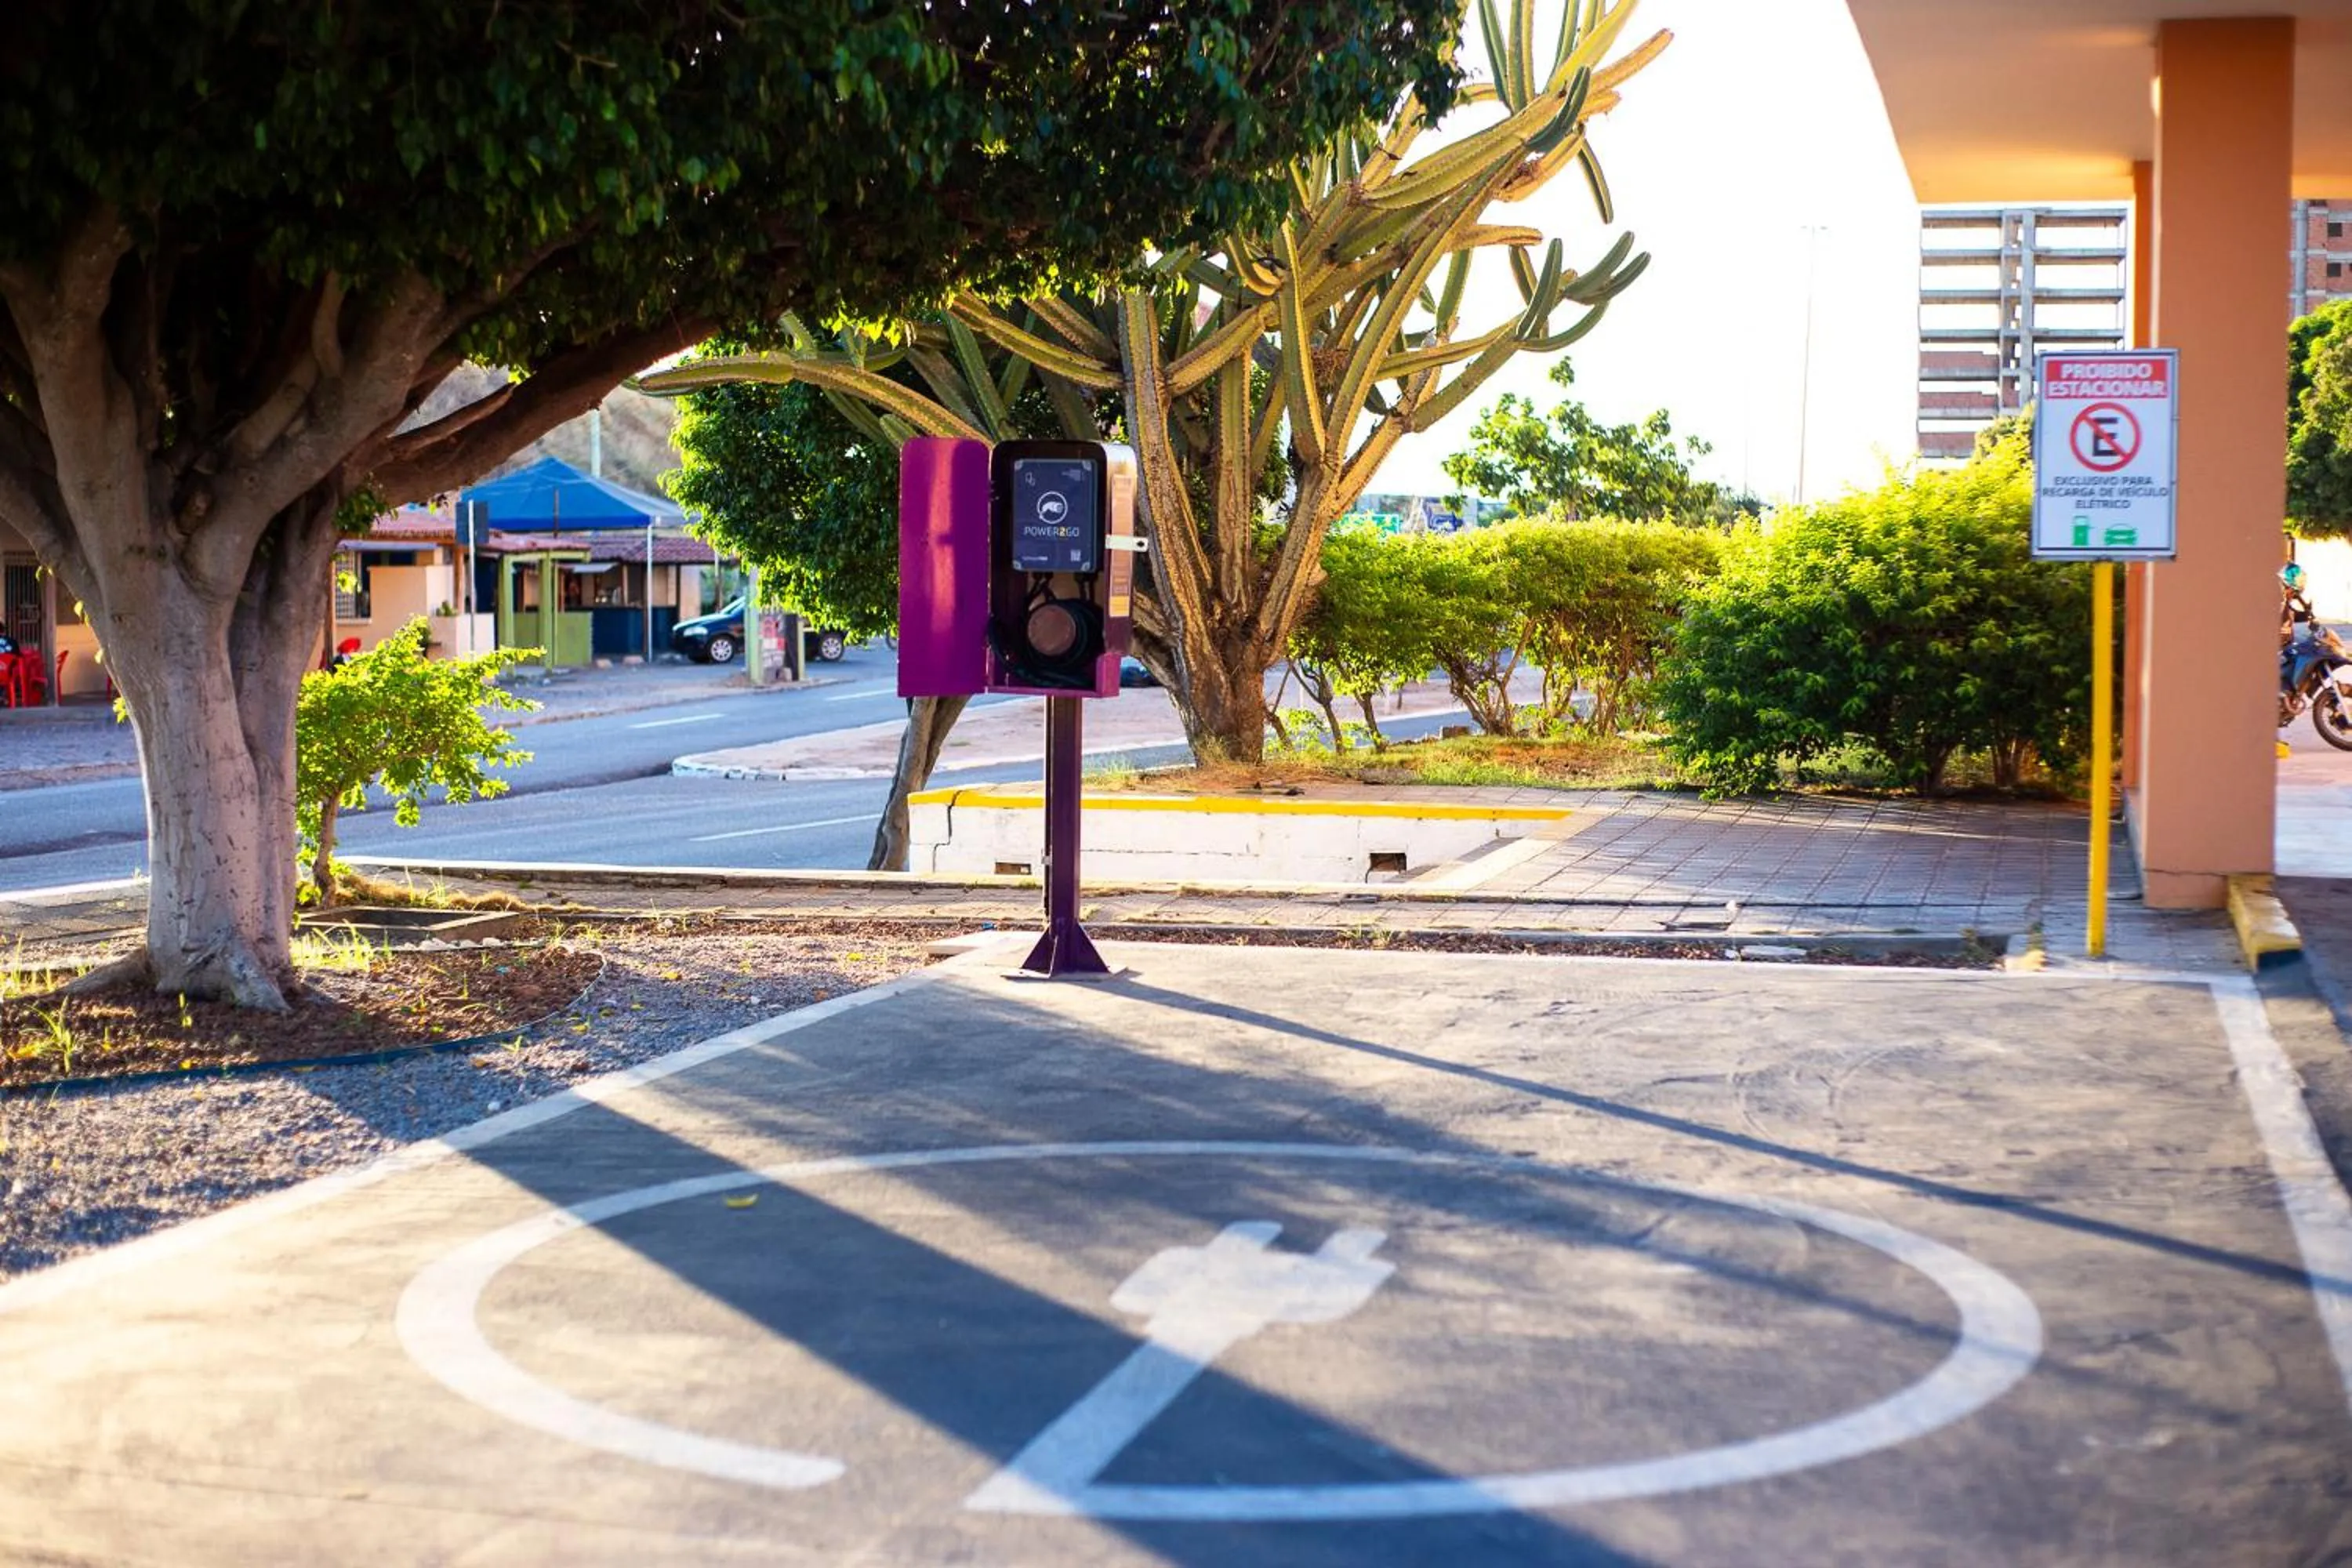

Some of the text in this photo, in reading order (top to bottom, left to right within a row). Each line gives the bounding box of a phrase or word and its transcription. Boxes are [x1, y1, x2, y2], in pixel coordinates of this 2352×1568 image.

[2061, 364, 2152, 378] PROIBIDO
[2049, 381, 2165, 395] ESTACIONAR
[2092, 418, 2118, 456] E
[2055, 477, 2152, 485] EXCLUSIVO PARA
[2043, 487, 2095, 496] RECARGA
[2100, 487, 2113, 496] DE
[1025, 527, 1079, 536] POWER2GO
